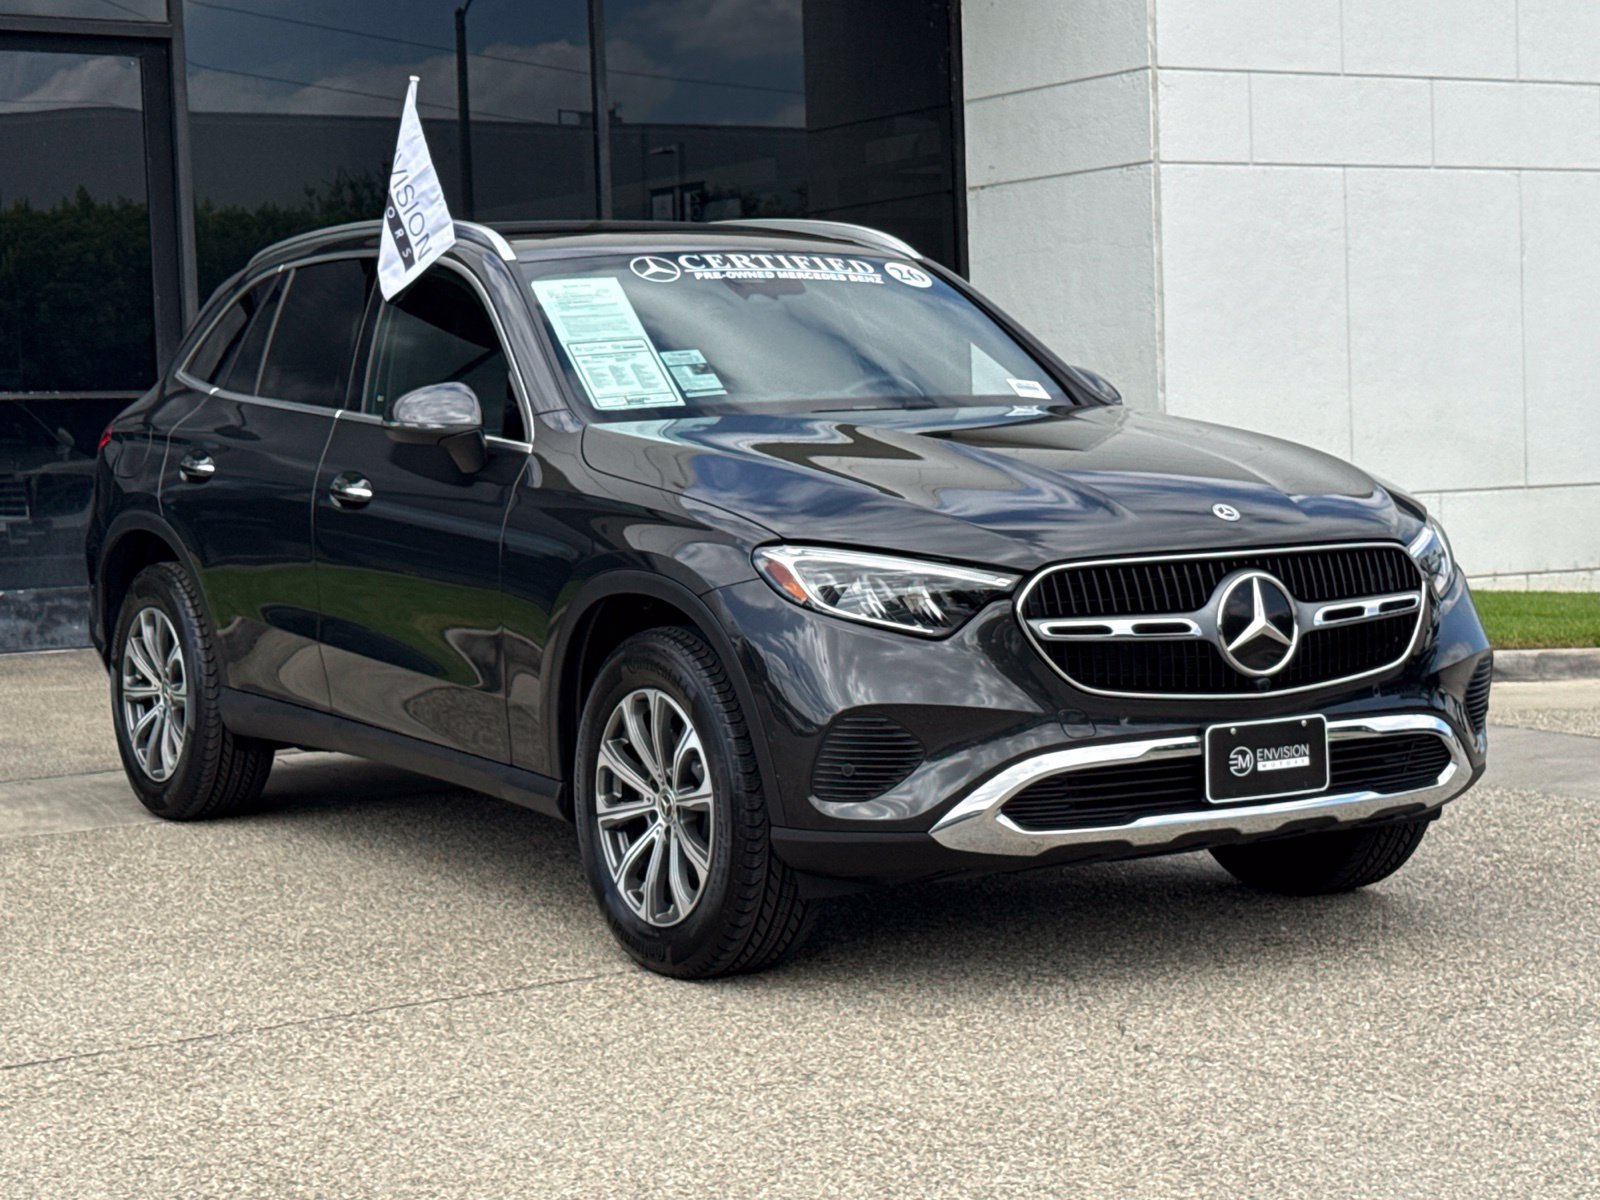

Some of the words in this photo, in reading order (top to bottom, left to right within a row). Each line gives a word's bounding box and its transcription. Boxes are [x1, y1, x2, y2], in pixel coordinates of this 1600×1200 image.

[391, 152, 432, 261] VISION
[386, 206, 412, 259] ORS
[678, 254, 874, 274] CERTIFIED
[694, 271, 775, 280] PRE-OWNED
[777, 271, 847, 282] MERCEDES
[850, 274, 885, 285] BENZ
[1256, 744, 1310, 761] ENVISION
